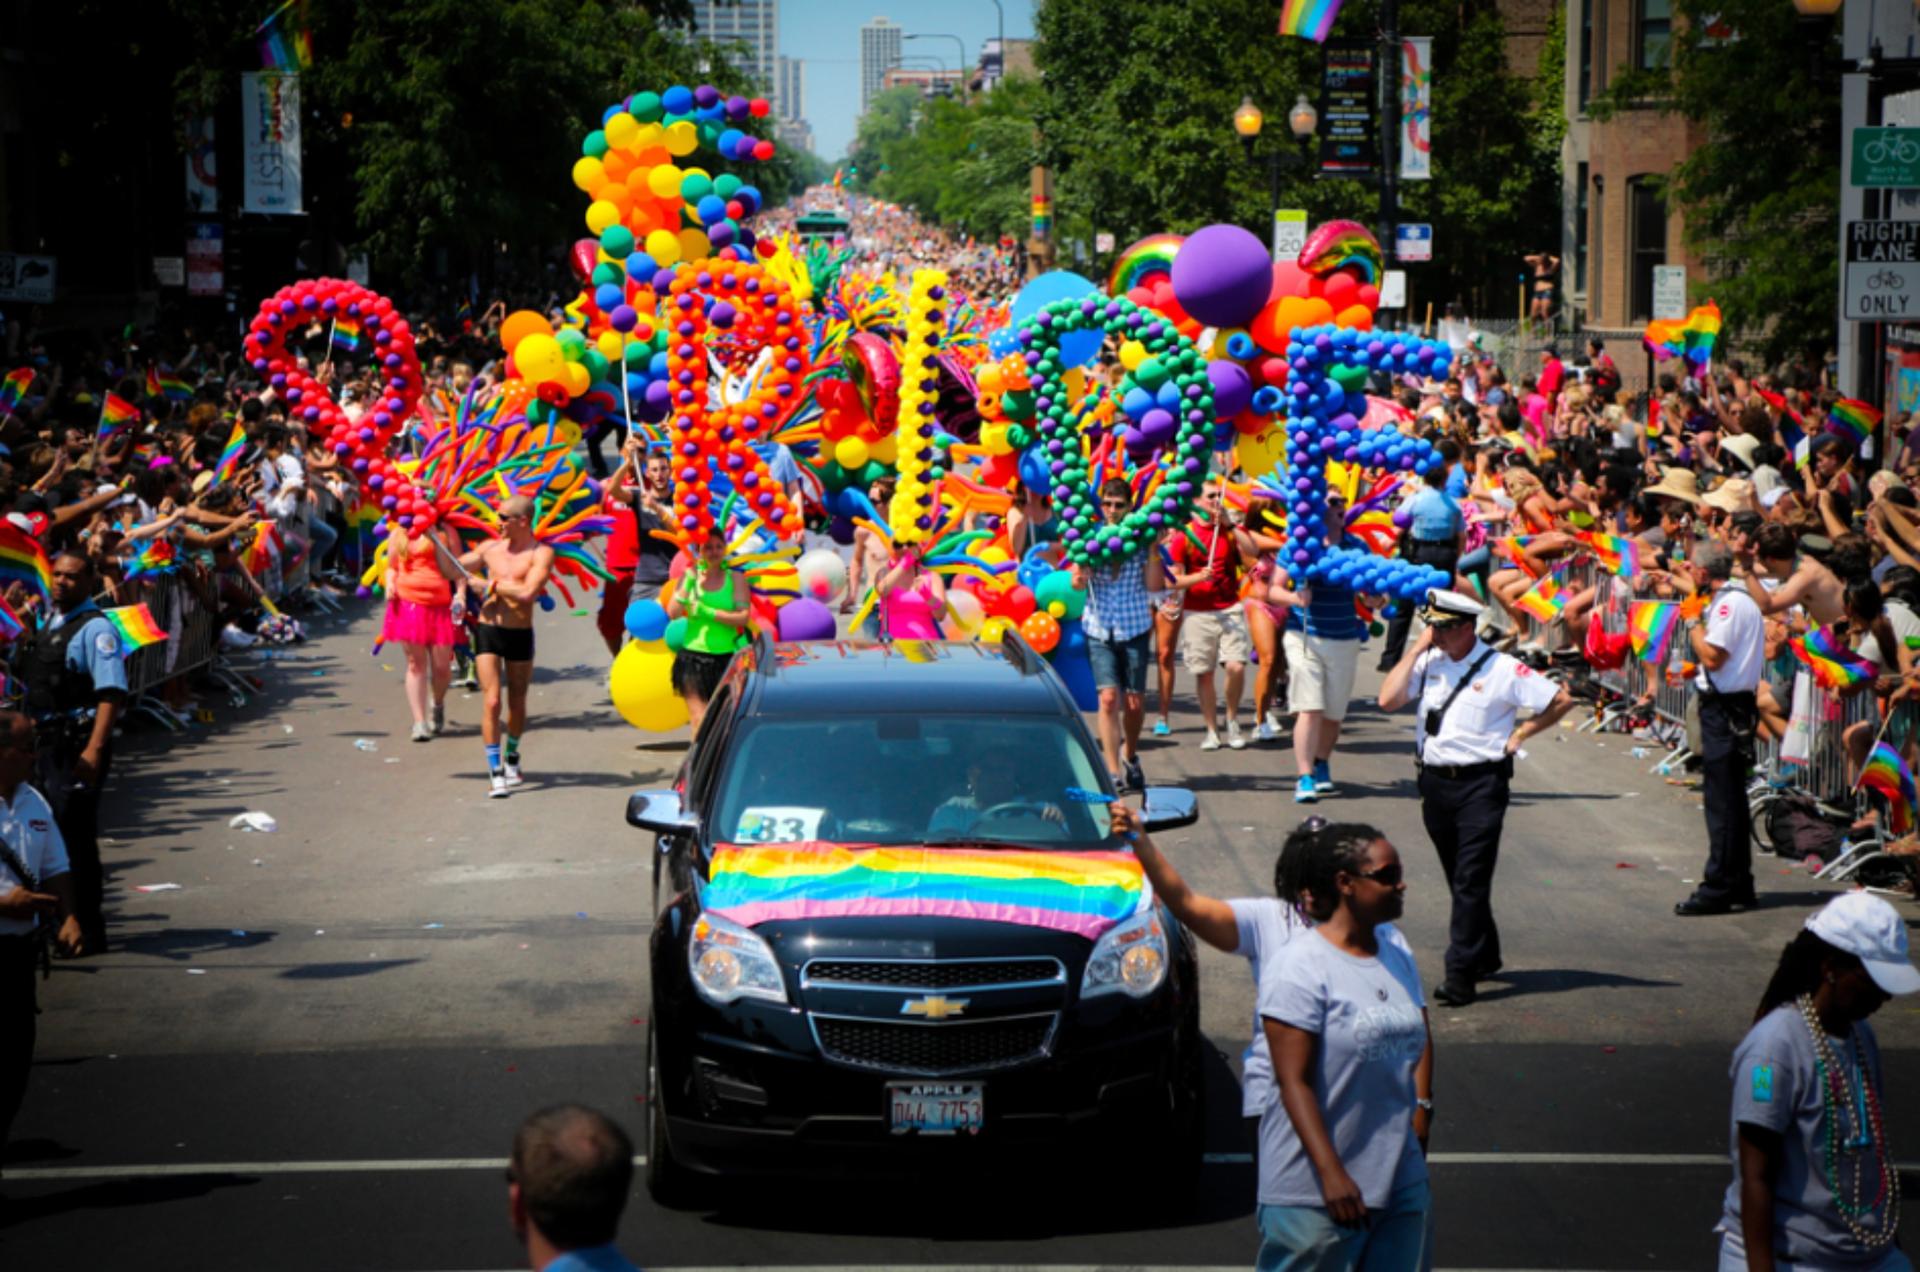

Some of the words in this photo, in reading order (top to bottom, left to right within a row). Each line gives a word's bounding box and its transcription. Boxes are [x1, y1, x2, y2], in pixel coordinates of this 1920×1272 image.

[1853, 222, 1920, 242] RIGHT
[1279, 238, 1300, 253] 20
[1856, 242, 1916, 261] LANE
[1860, 295, 1911, 314] ONLY
[750, 815, 805, 843] 83
[910, 1085, 963, 1095] APPLE
